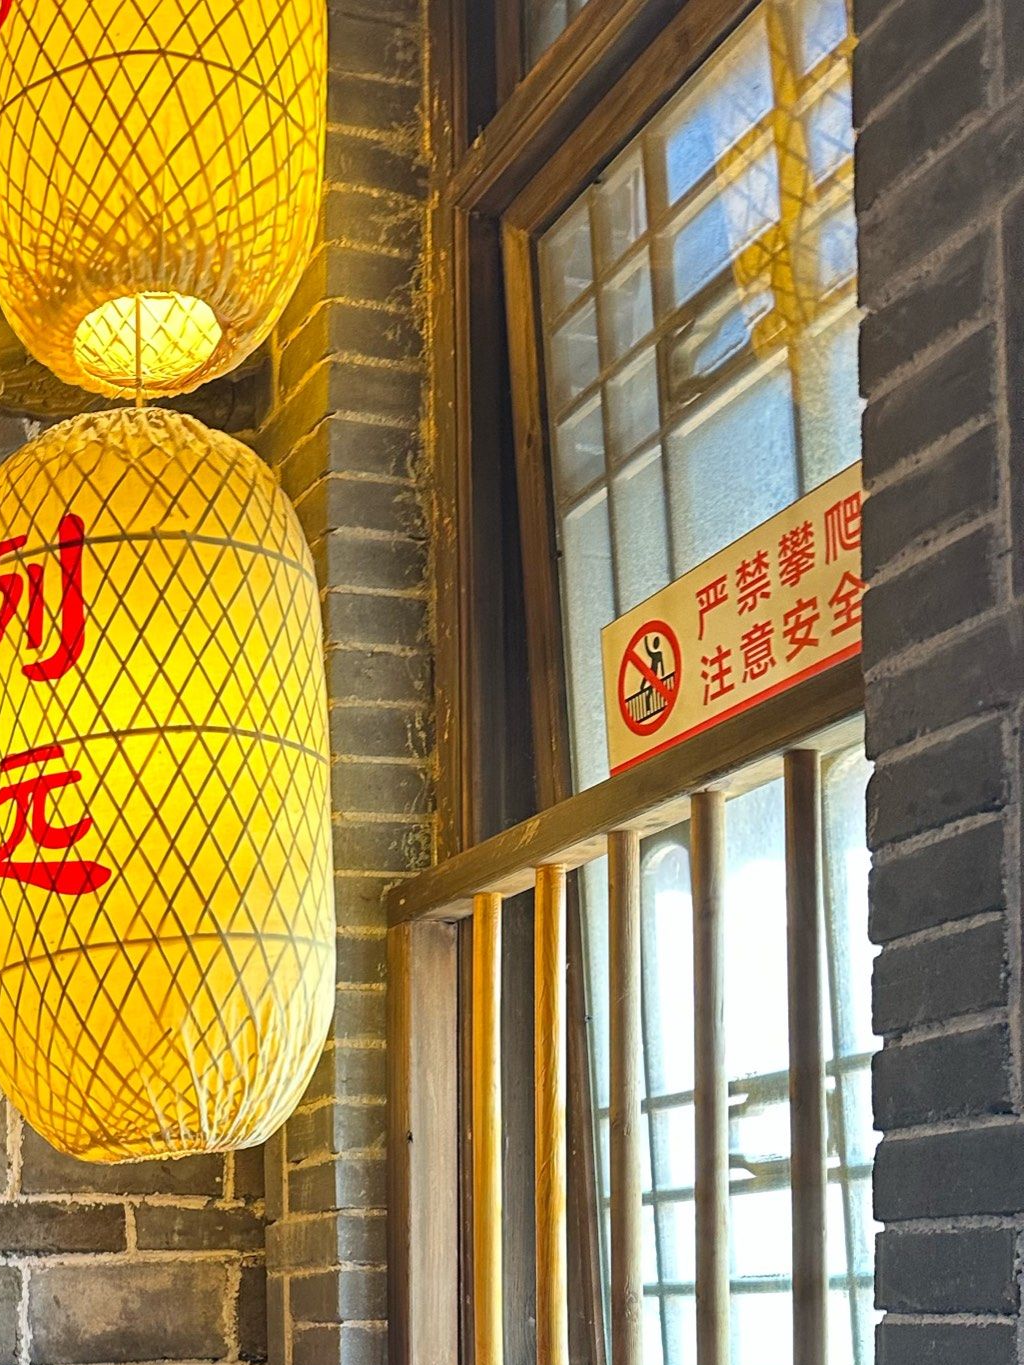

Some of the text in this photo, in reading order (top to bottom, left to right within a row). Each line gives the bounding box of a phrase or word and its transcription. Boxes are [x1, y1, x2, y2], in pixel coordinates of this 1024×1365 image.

[695, 491, 863, 641] 严禁攀爬
[700, 570, 866, 706] 注意安全
